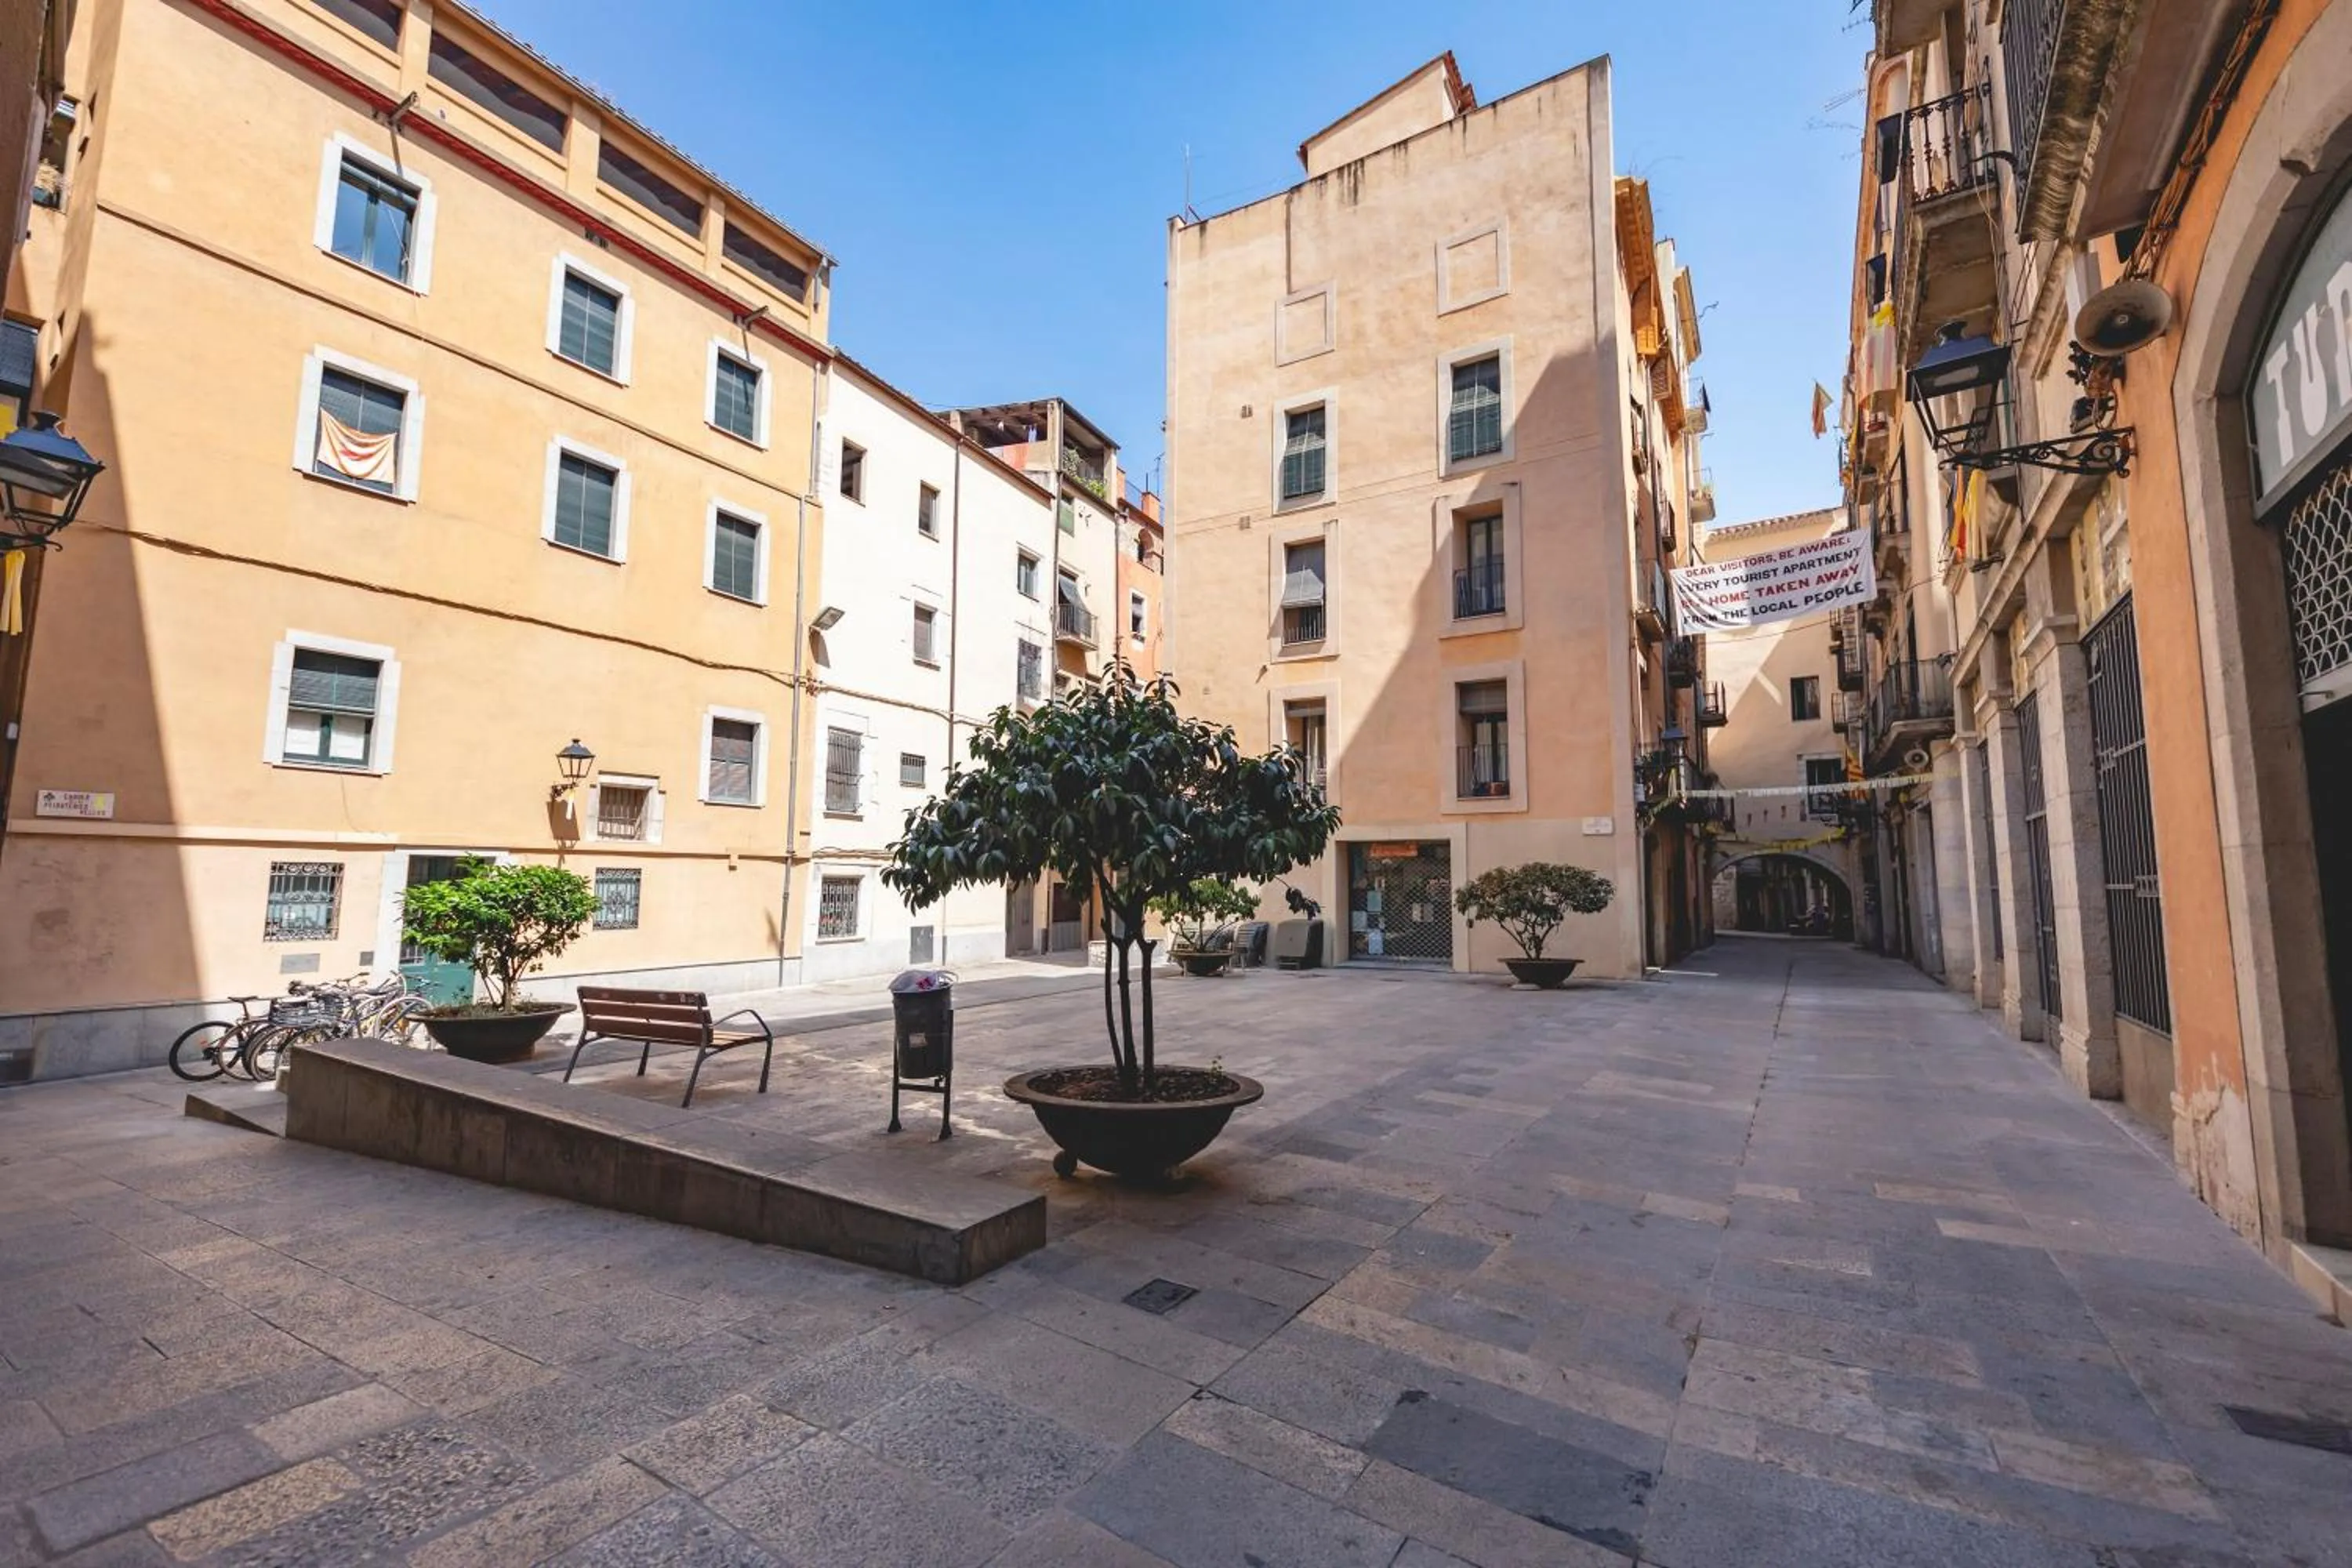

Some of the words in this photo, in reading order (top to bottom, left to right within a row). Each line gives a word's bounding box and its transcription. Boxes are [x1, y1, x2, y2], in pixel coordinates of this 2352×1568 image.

[1686, 567, 1715, 578] DEAR
[1719, 554, 1777, 572] VISITORS,
[1779, 548, 1795, 561] BE
[1723, 567, 1779, 586] TOURIST
[1783, 546, 1862, 575] APARTMENT
[1709, 590, 1751, 606] HOME
[1755, 577, 1809, 597] TAKEN
[1816, 564, 1859, 586] AWAY
[1722, 608, 1748, 619] THE
[1751, 600, 1798, 615] LOCAL
[1804, 581, 1864, 605] PEOPLE
